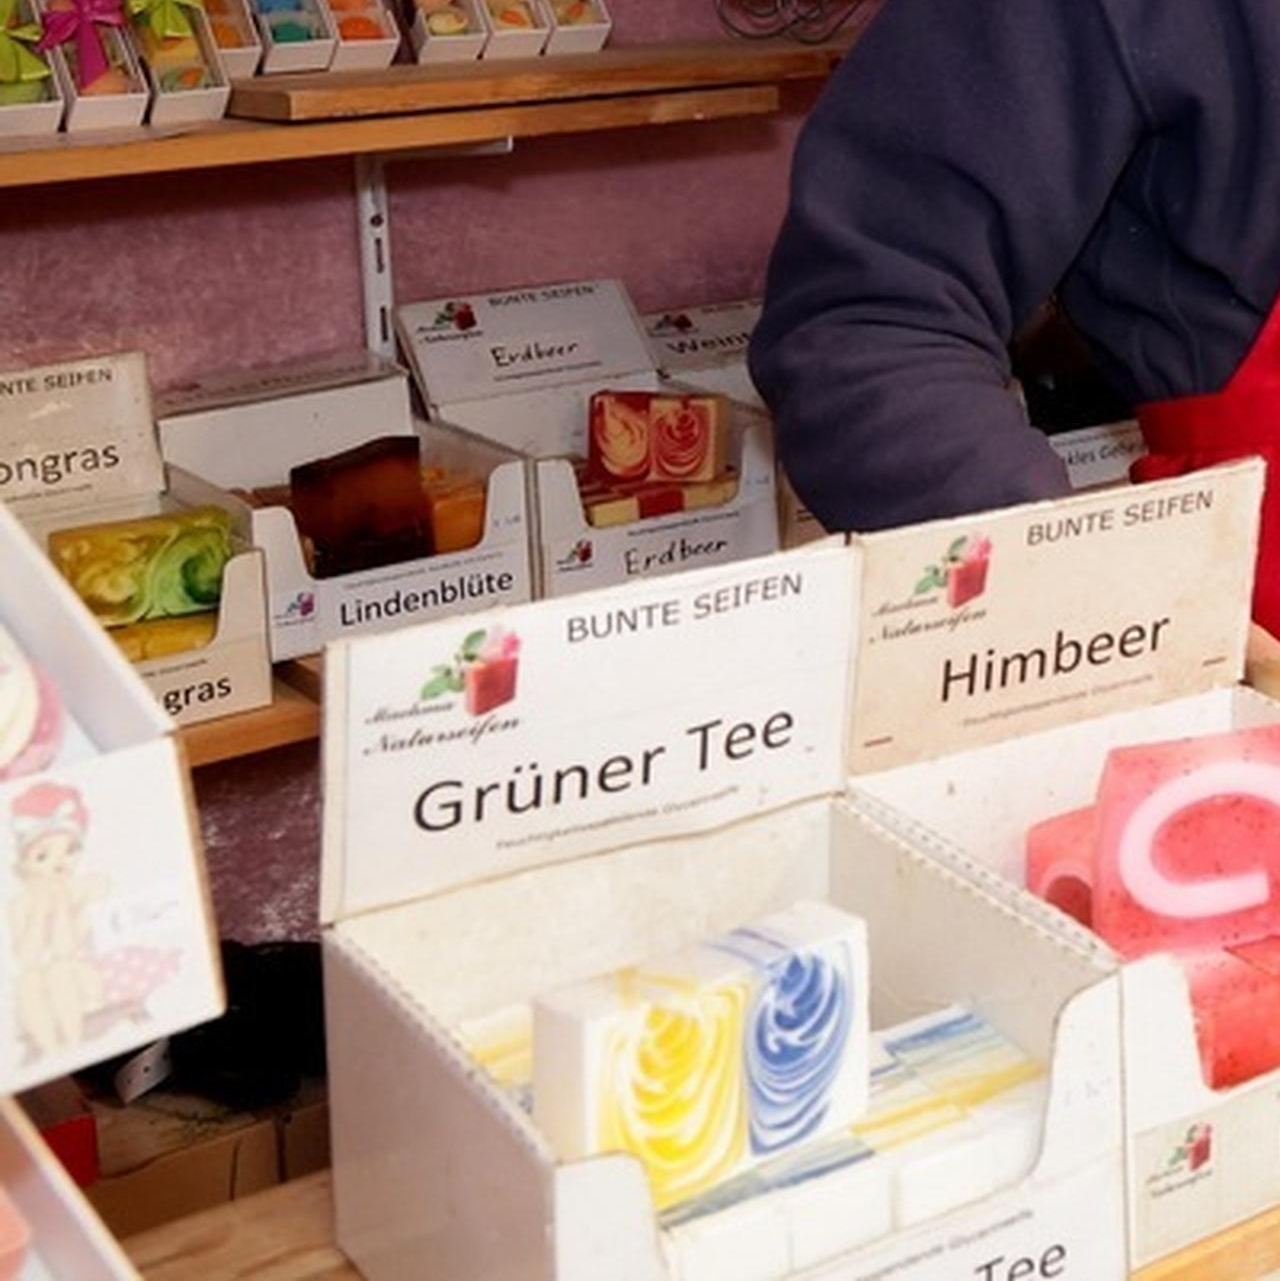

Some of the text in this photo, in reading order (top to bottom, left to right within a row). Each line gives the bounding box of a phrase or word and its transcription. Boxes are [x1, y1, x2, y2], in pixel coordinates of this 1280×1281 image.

[491, 341, 579, 368] Erdbeer
[0, 378, 37, 396] NTE
[0, 443, 120, 485] ongras
[1026, 489, 1214, 547] BUNTE SEIFEN
[624, 538, 728, 575] Erdbeer
[340, 570, 514, 627] Lindenblüte
[566, 573, 804, 644] BUNTE SEIFEN
[940, 616, 1171, 704] Himbeer
[164, 673, 233, 716] gras
[361, 712, 521, 759] Naturseifen
[414, 743, 666, 833] Grüner
[685, 709, 796, 772] Tee
